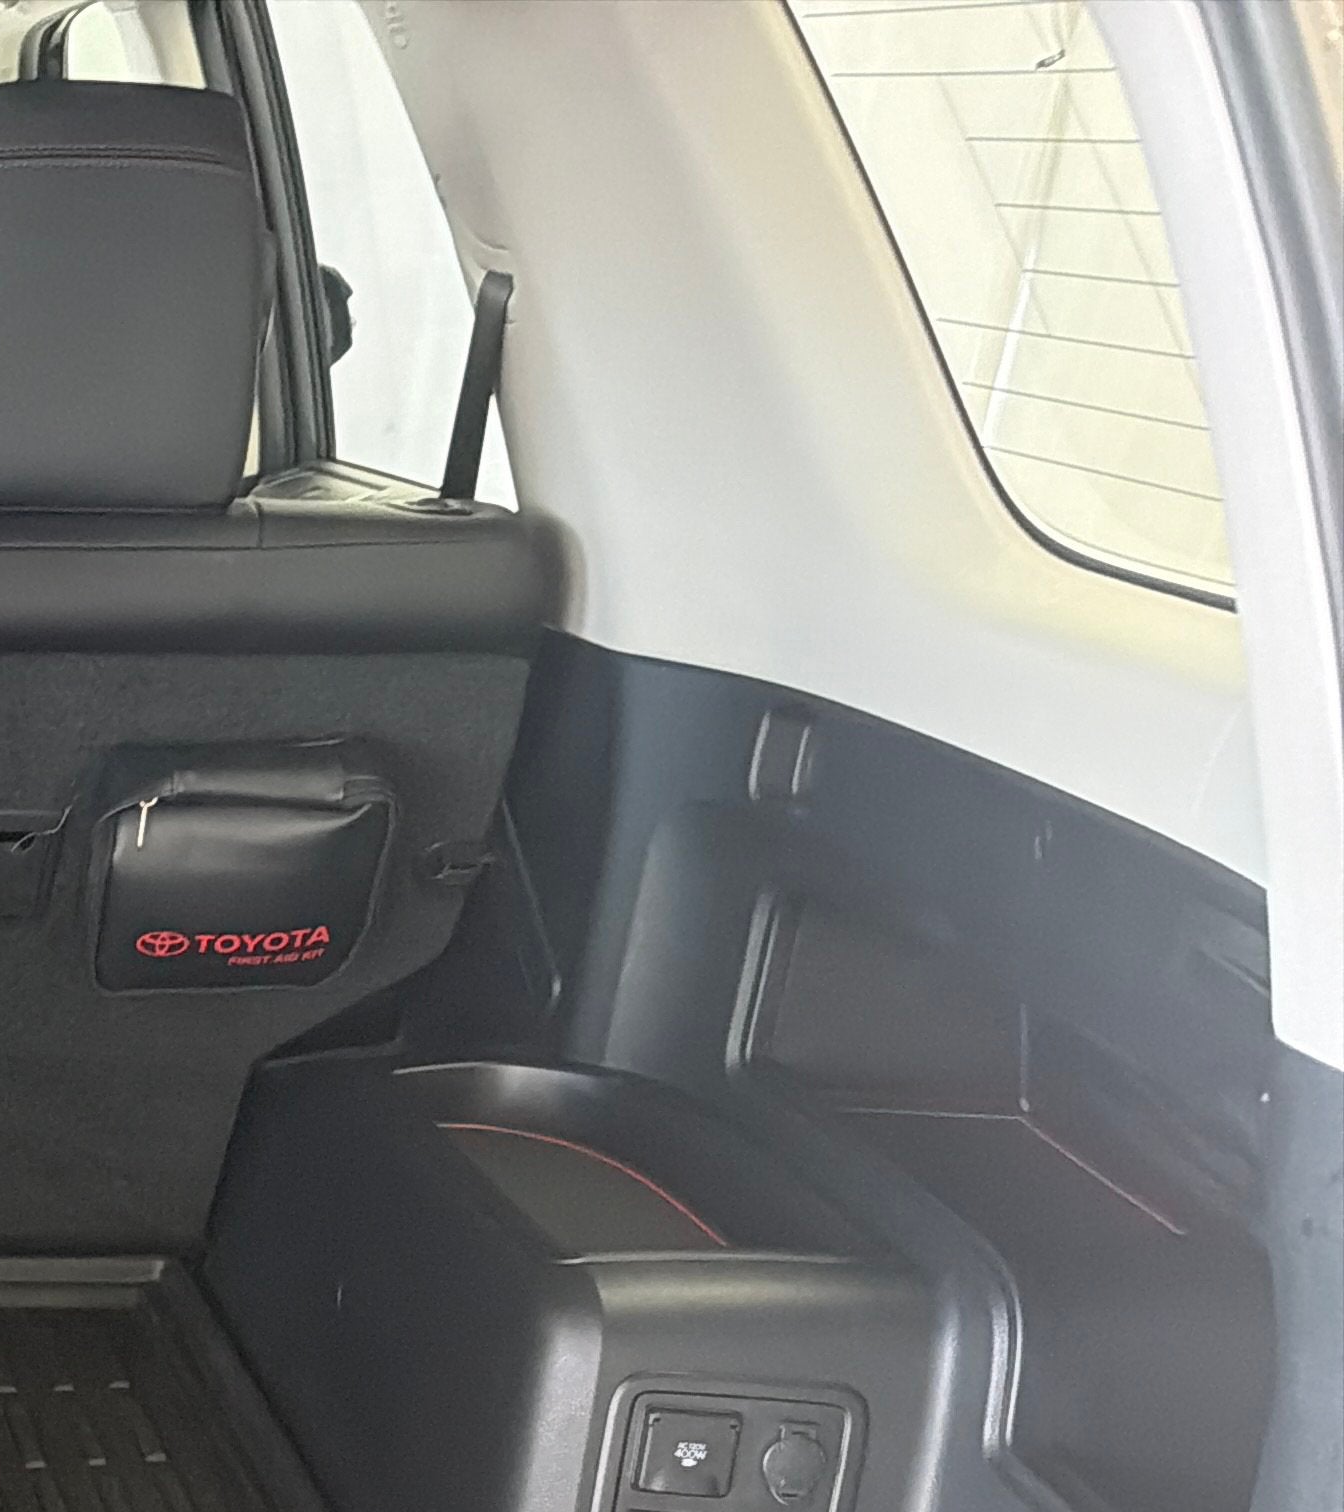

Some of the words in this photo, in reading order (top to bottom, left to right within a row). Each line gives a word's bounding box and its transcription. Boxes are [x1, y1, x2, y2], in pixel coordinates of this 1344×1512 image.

[194, 925, 330, 954] TOYOTA
[227, 954, 272, 966] FIRST
[273, 951, 300, 963] AID
[301, 947, 326, 961] KIT
[673, 1448, 708, 1460] 400W
